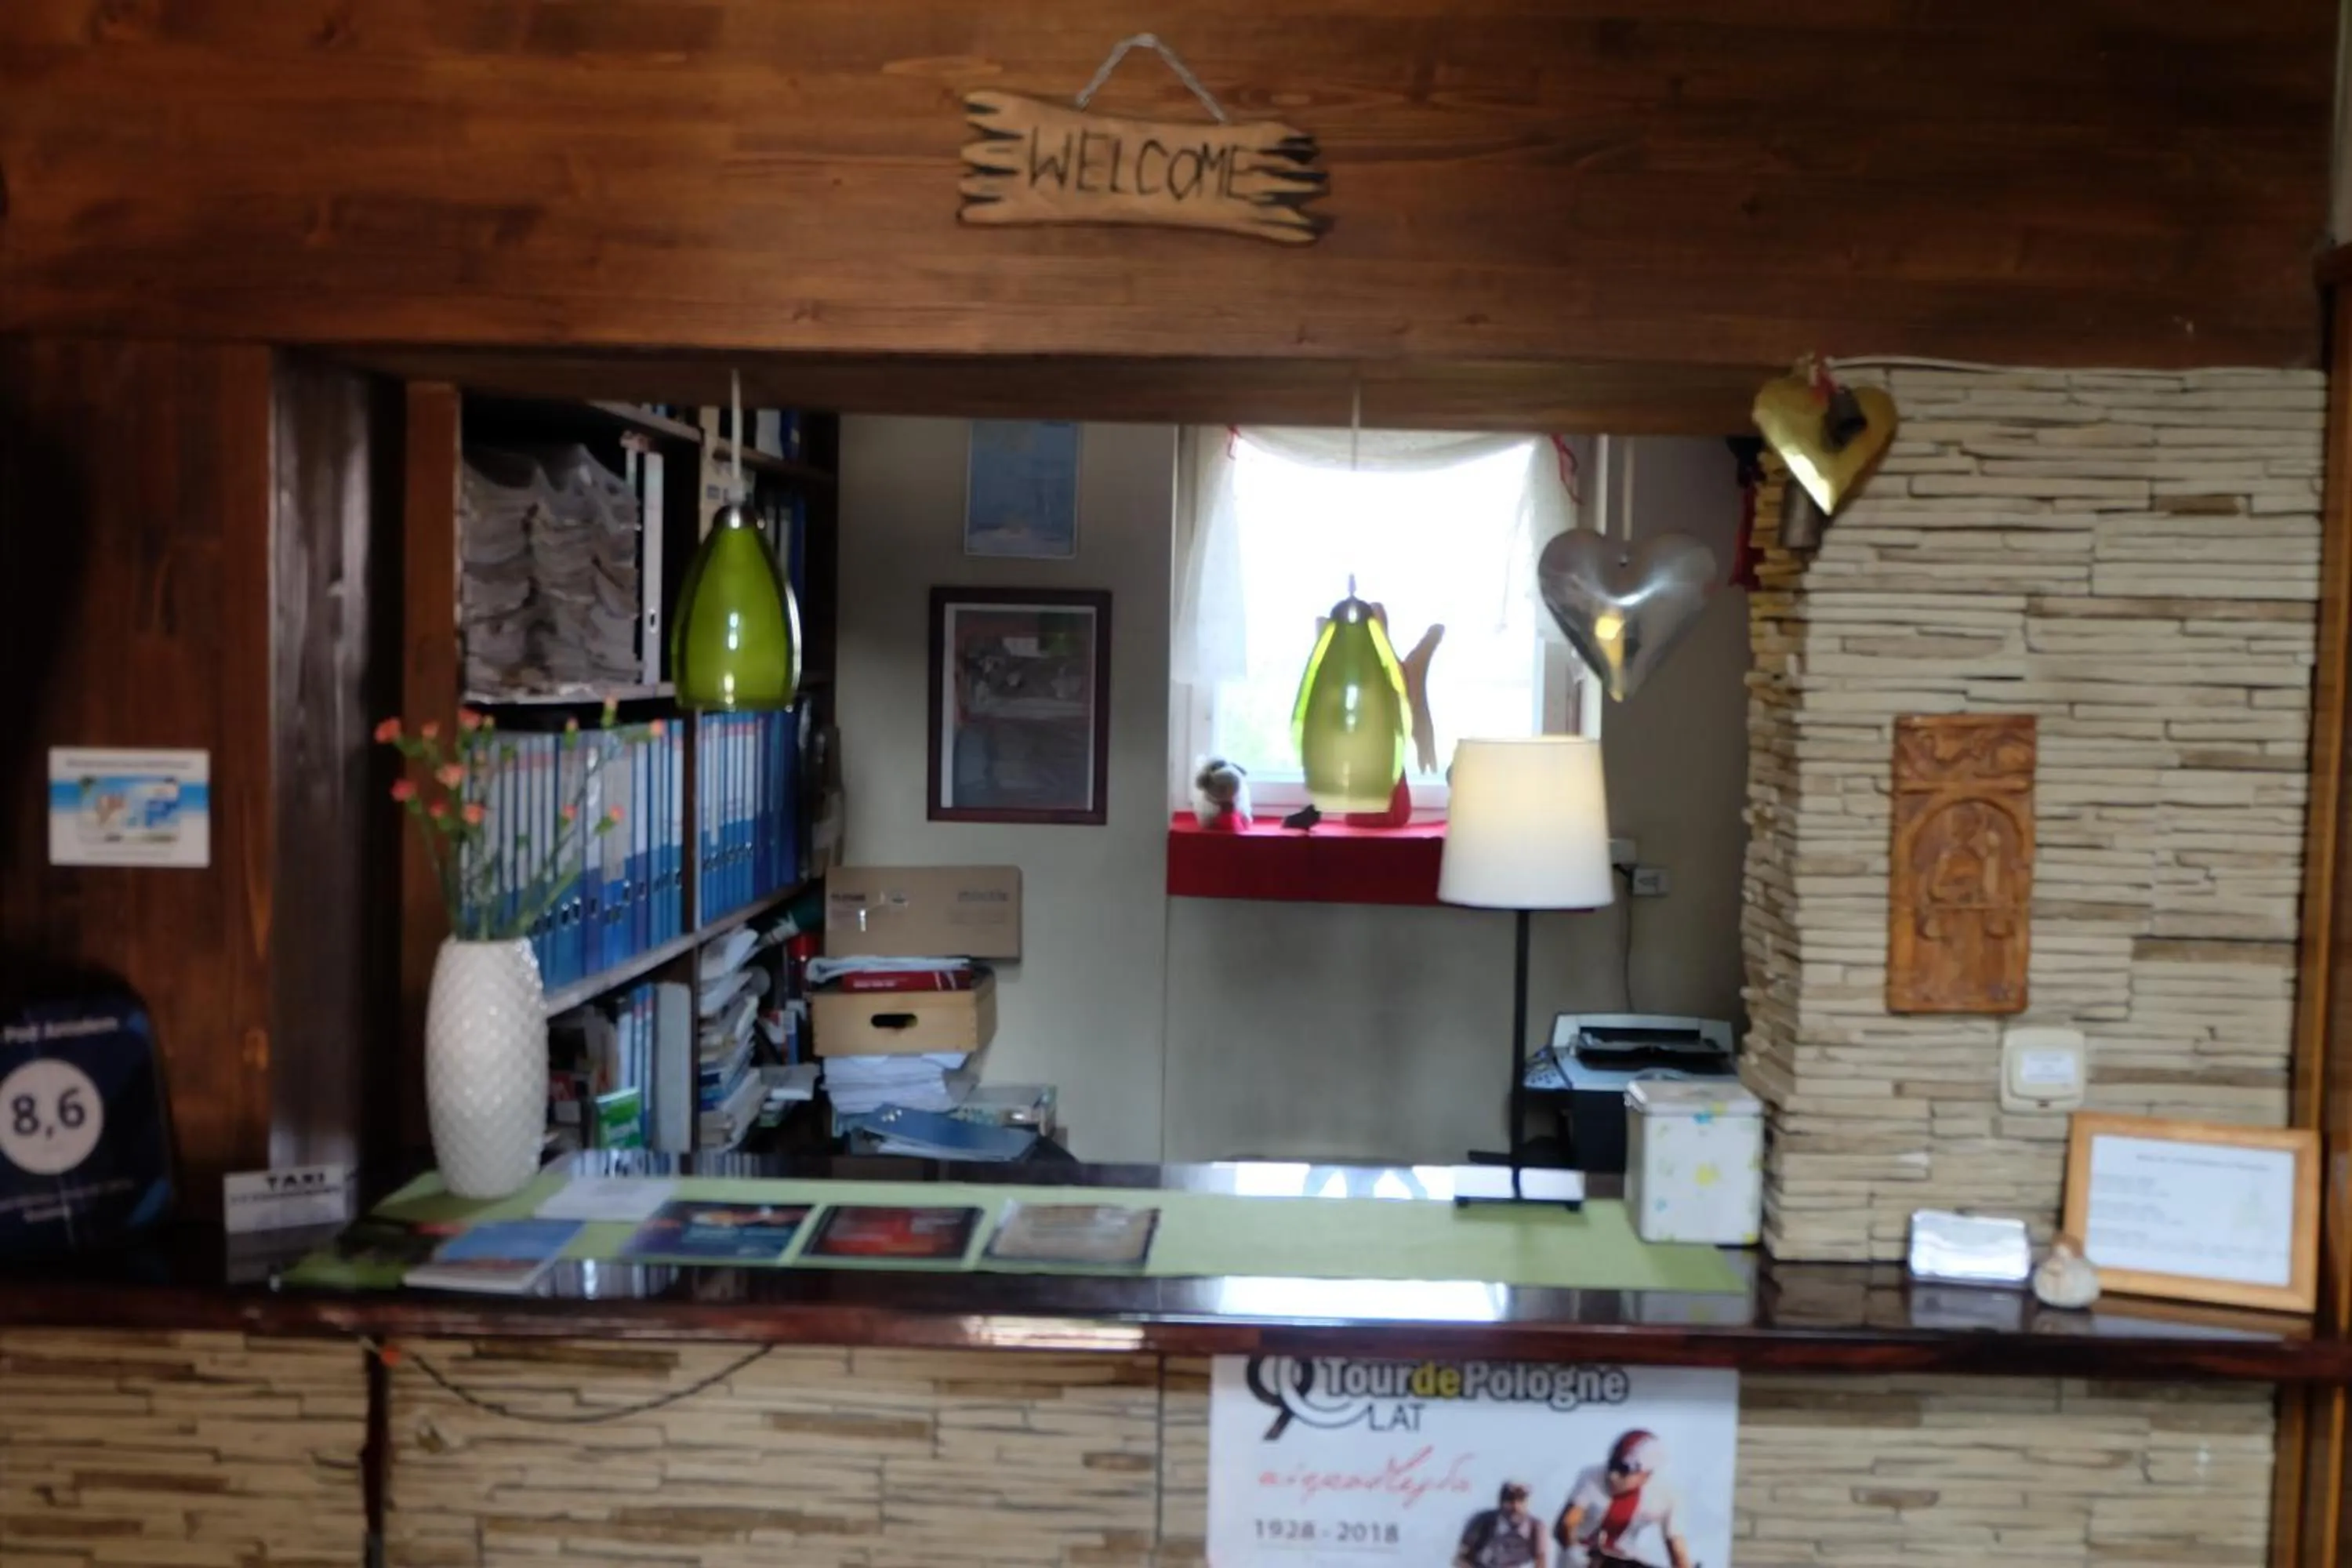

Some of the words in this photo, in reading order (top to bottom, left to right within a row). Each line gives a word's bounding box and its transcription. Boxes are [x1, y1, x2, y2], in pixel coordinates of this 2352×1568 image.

[1028, 125, 1254, 201] WELCOME
[12, 1087, 86, 1141] 8,6
[1368, 1403, 1425, 1432] LAT
[1255, 1519, 1316, 1540] 1928
[1337, 1521, 1400, 1544] 2018
